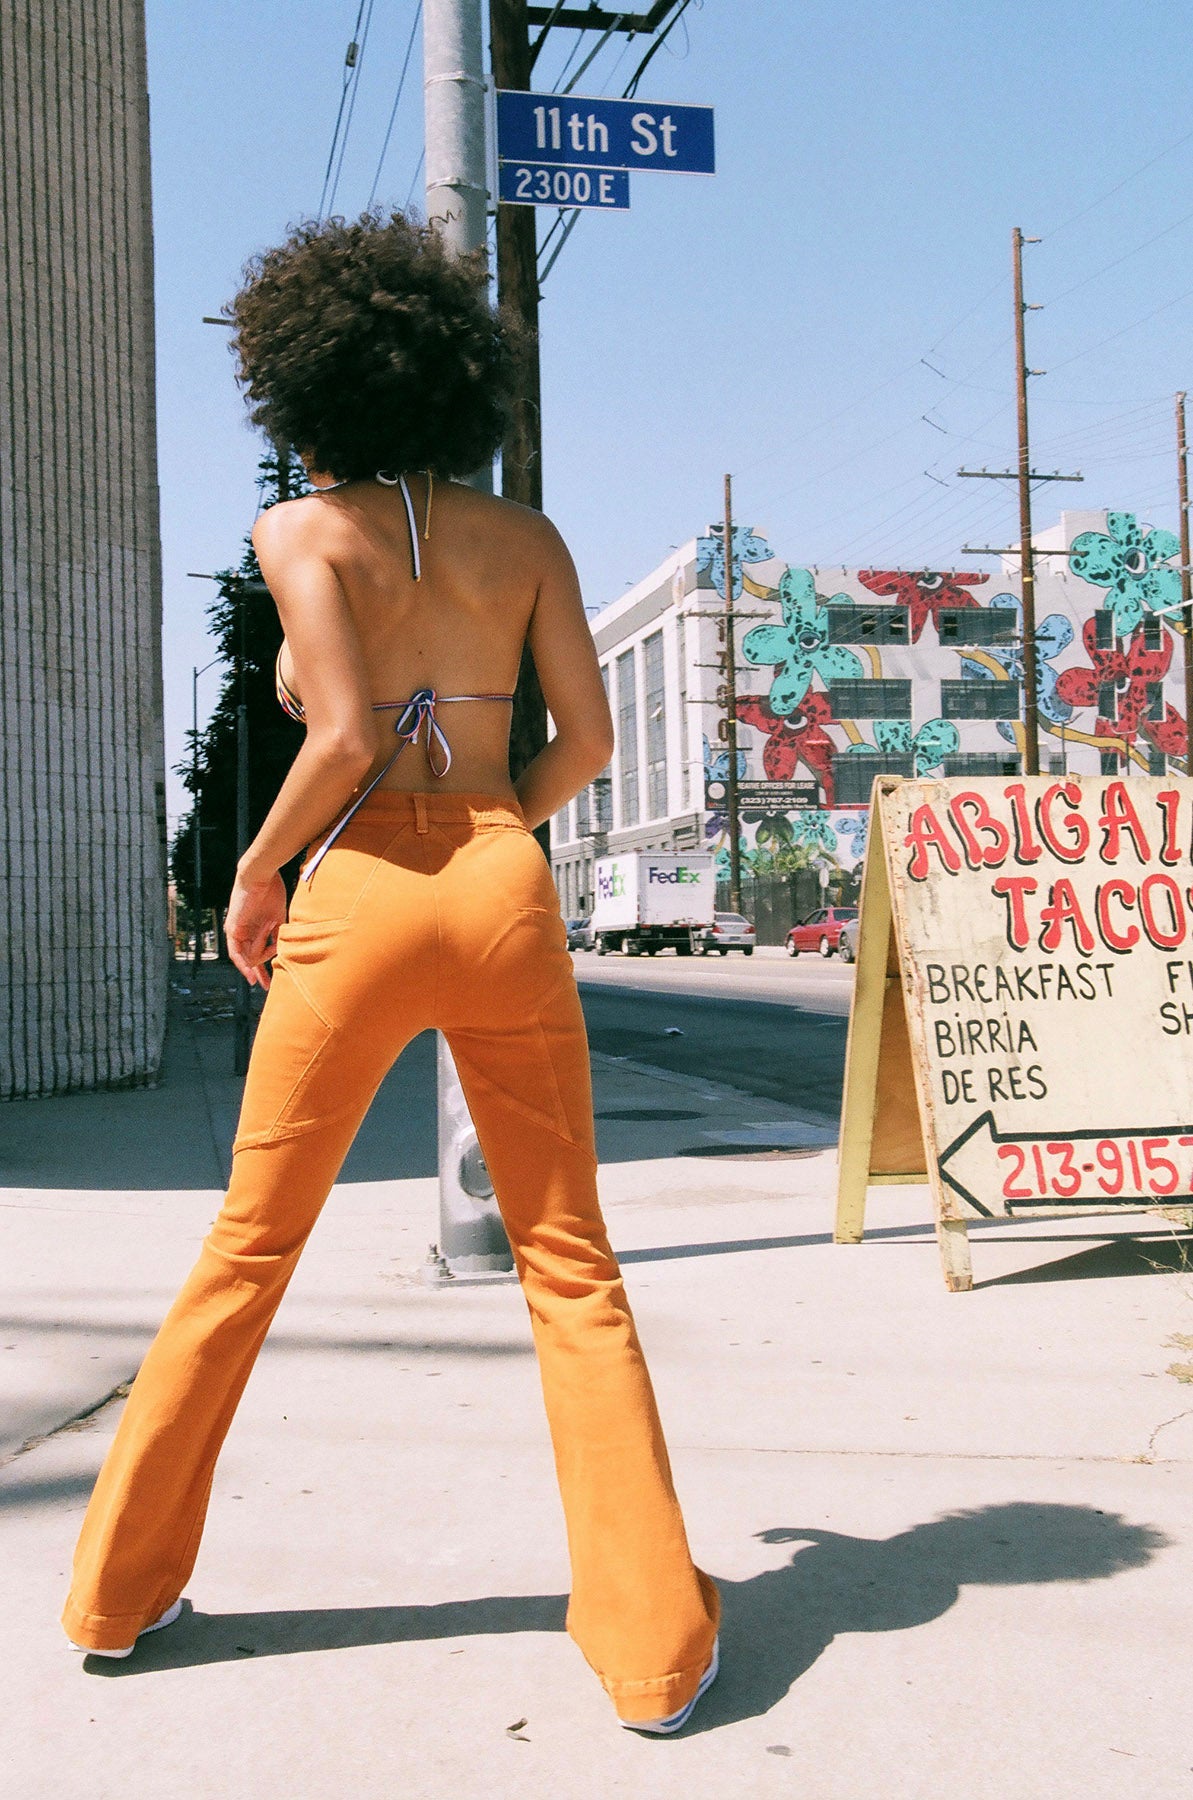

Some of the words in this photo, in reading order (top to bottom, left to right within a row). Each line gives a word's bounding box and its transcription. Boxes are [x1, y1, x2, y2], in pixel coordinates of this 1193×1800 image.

[532, 105, 609, 153] 11th
[630, 112, 678, 157] St
[515, 168, 591, 203] 2300
[599, 174, 616, 204] E
[904, 781, 1193, 882] ABIGAI
[649, 866, 701, 884] FedEx
[991, 874, 1193, 957] TACO
[926, 963, 1115, 1005] BREAKFAST
[941, 1069, 977, 1106] DE
[988, 1065, 1048, 1103] RES
